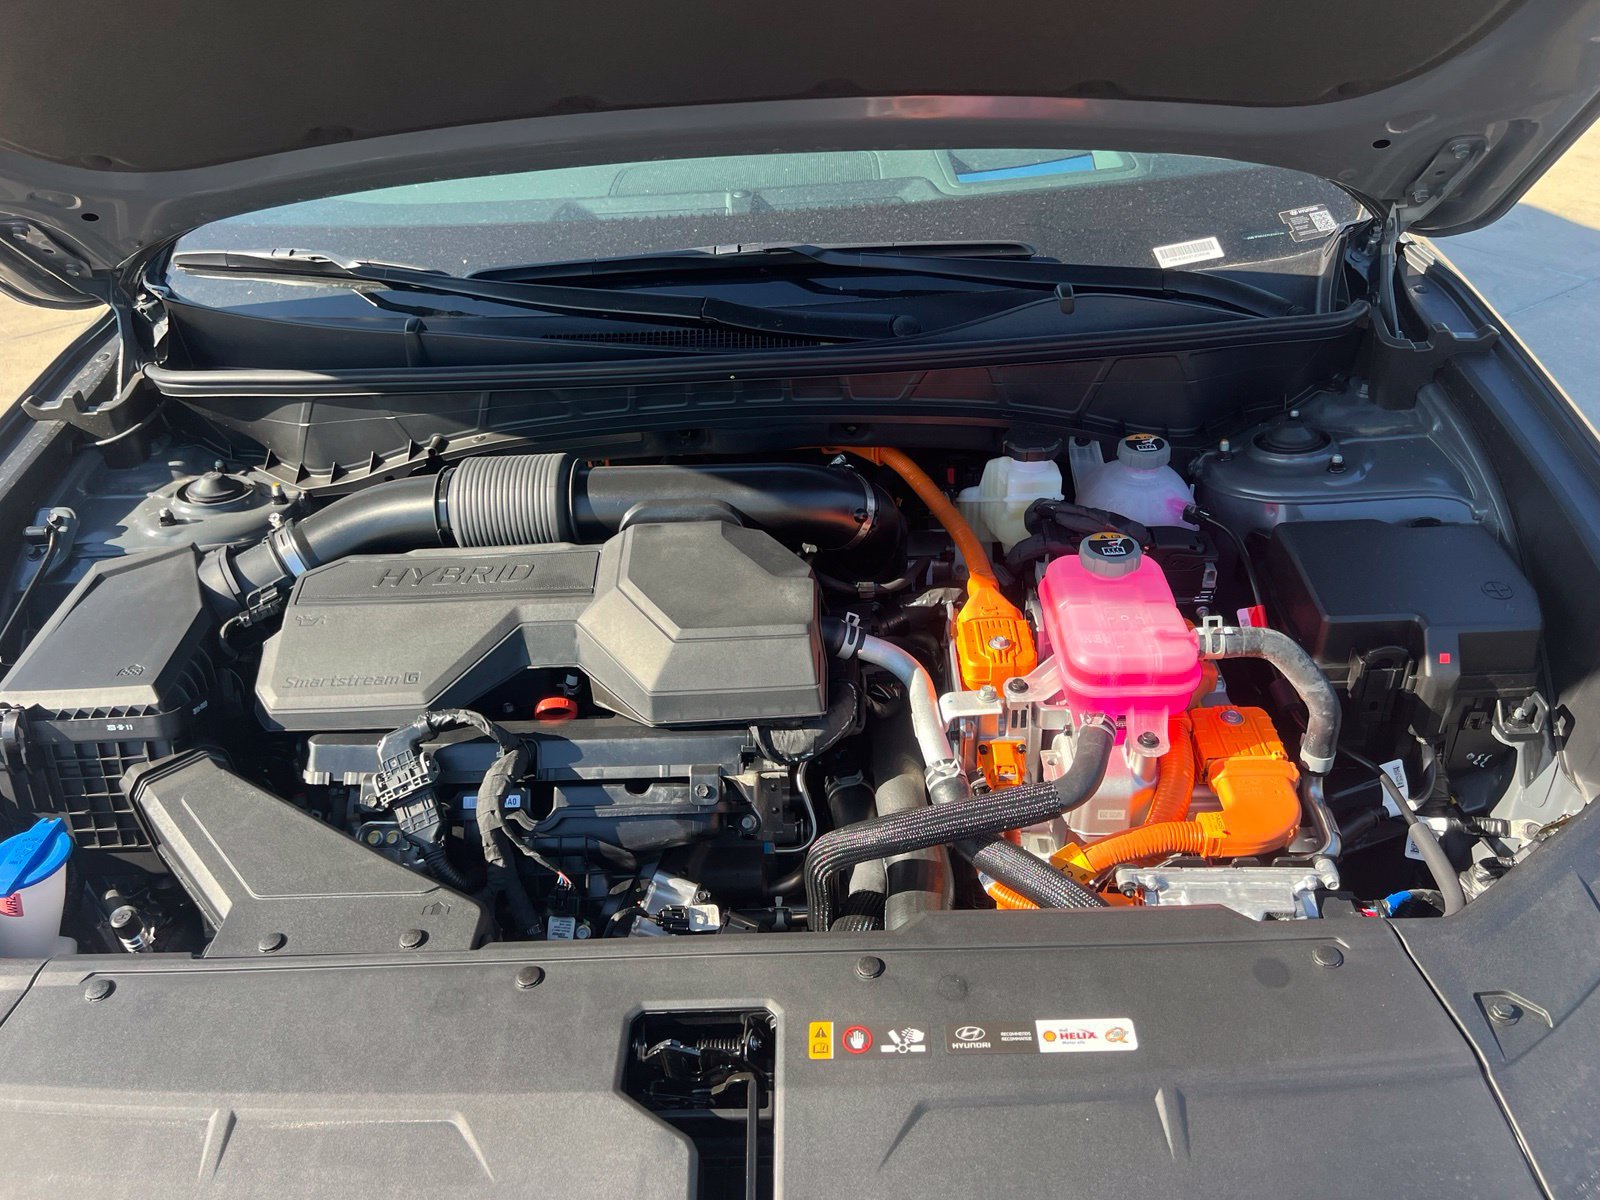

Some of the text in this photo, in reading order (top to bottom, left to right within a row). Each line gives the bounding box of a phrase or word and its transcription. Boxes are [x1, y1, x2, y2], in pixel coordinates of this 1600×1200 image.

[372, 563, 535, 588] HYBRID
[282, 672, 401, 689] Smartstream
[1060, 1031, 1097, 1040] HELIX
